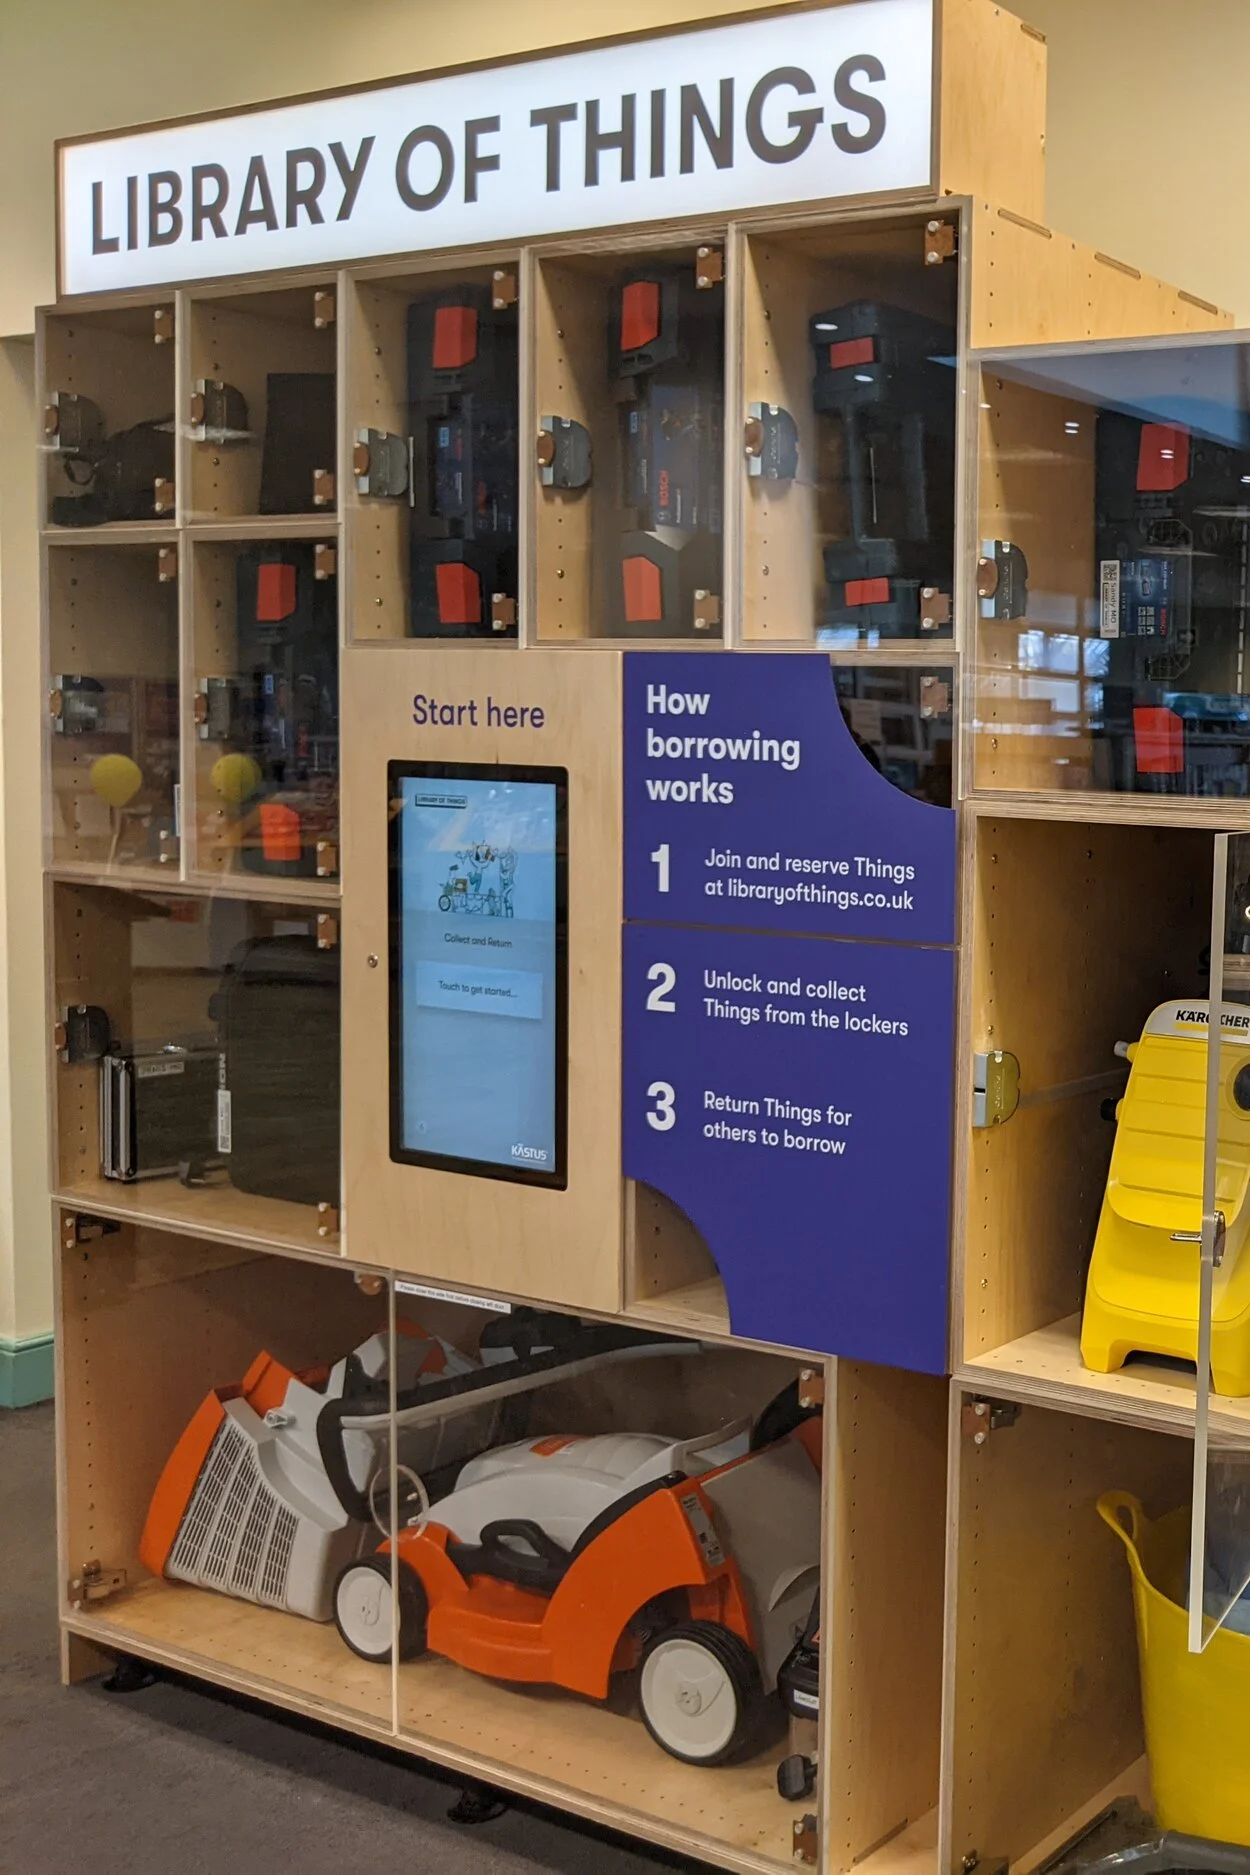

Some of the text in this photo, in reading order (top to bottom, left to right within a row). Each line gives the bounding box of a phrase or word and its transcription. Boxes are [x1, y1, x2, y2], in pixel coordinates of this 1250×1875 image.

[92, 54, 887, 255] LIBRARY OF THINGS
[413, 694, 545, 728] Start here
[646, 684, 711, 716] How
[646, 728, 801, 771] borrowing
[646, 773, 734, 804] works
[651, 844, 670, 892] 1
[705, 848, 916, 884] Join and reserve Things
[705, 878, 914, 910] at libraryofthings.co.uk
[444, 932, 513, 948] Collect and Return
[438, 980, 460, 991] Touch
[461, 983, 470, 993] to
[471, 985, 483, 996] get
[646, 962, 676, 1012] 2
[704, 969, 867, 1002] Unlock and collect
[703, 998, 909, 1036] Things from the lockers
[646, 1081, 676, 1131] 3
[704, 1091, 852, 1126] Return Things for
[704, 1121, 846, 1155] others to borrow
